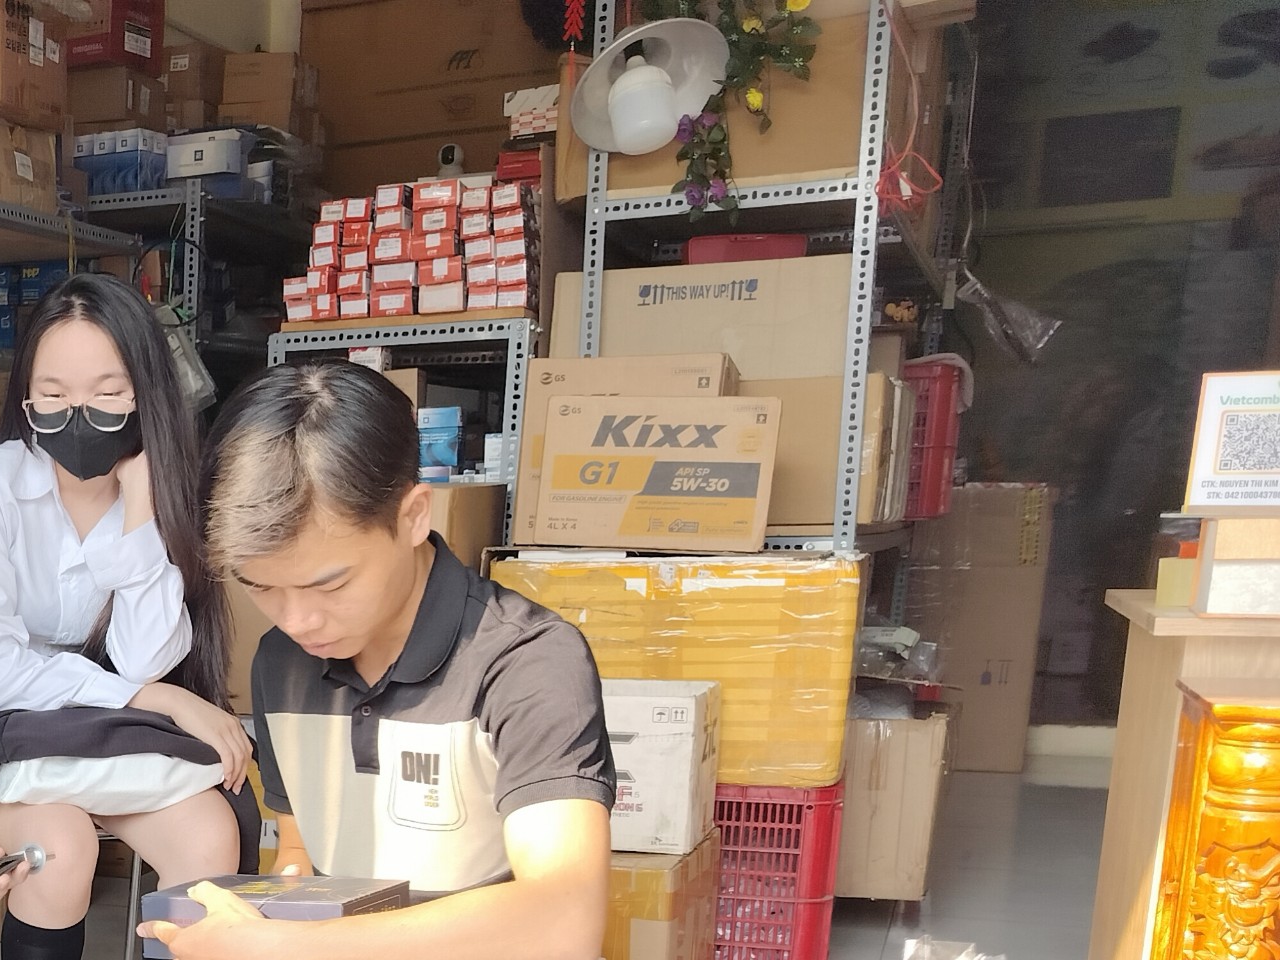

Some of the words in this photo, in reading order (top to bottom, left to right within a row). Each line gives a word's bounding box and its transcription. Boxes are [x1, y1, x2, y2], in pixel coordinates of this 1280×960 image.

[666, 286, 687, 301] THIS
[689, 284, 711, 300] WAY
[713, 283, 730, 299] UP!
[554, 374, 566, 382] GS
[571, 407, 582, 415] GS
[591, 414, 727, 449] Kixx
[579, 460, 620, 485] G1
[675, 467, 695, 476] API
[696, 467, 711, 476] SP
[670, 478, 730, 492] 5W-30
[1219, 480, 1249, 488] NGUYEN
[1251, 480, 1263, 488] THI
[1264, 480, 1279, 488] KIM
[547, 522, 559, 530] 4L
[401, 750, 440, 785] ON!
